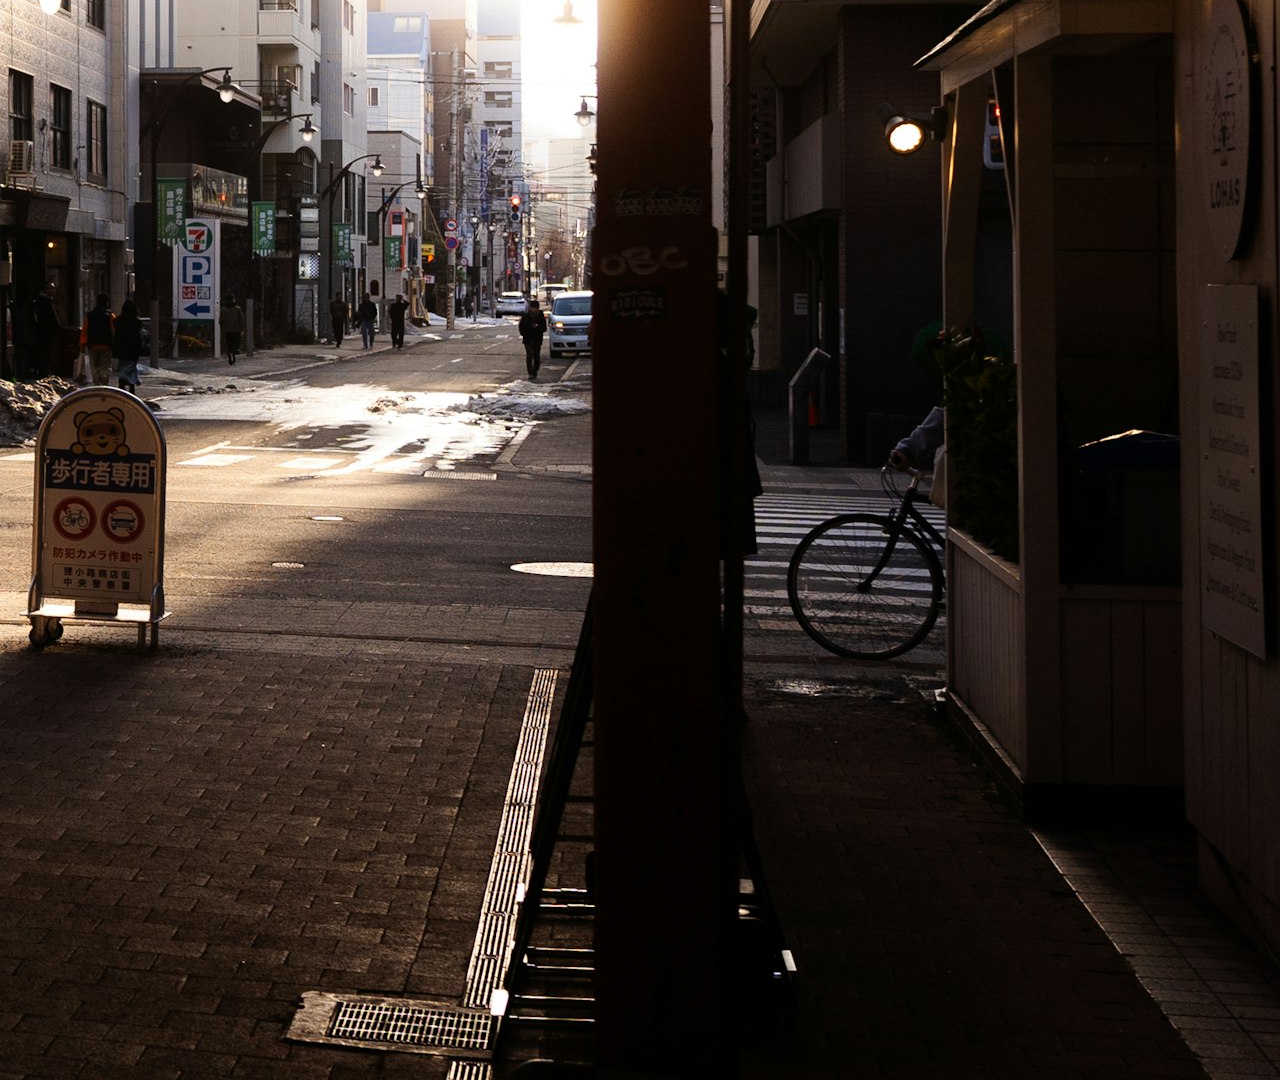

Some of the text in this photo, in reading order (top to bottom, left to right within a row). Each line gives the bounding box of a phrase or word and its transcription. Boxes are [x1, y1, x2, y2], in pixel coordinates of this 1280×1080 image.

[1210, 179, 1240, 210] LOHAS
[186, 257, 209, 283] P
[600, 246, 688, 276] OBC
[51, 458, 151, 489] 歩行者専用
[52, 546, 143, 564] 防犯カメラ作動中
[63, 566, 131, 581] 狸小路商店街
[63, 578, 130, 592] 中央警察署
